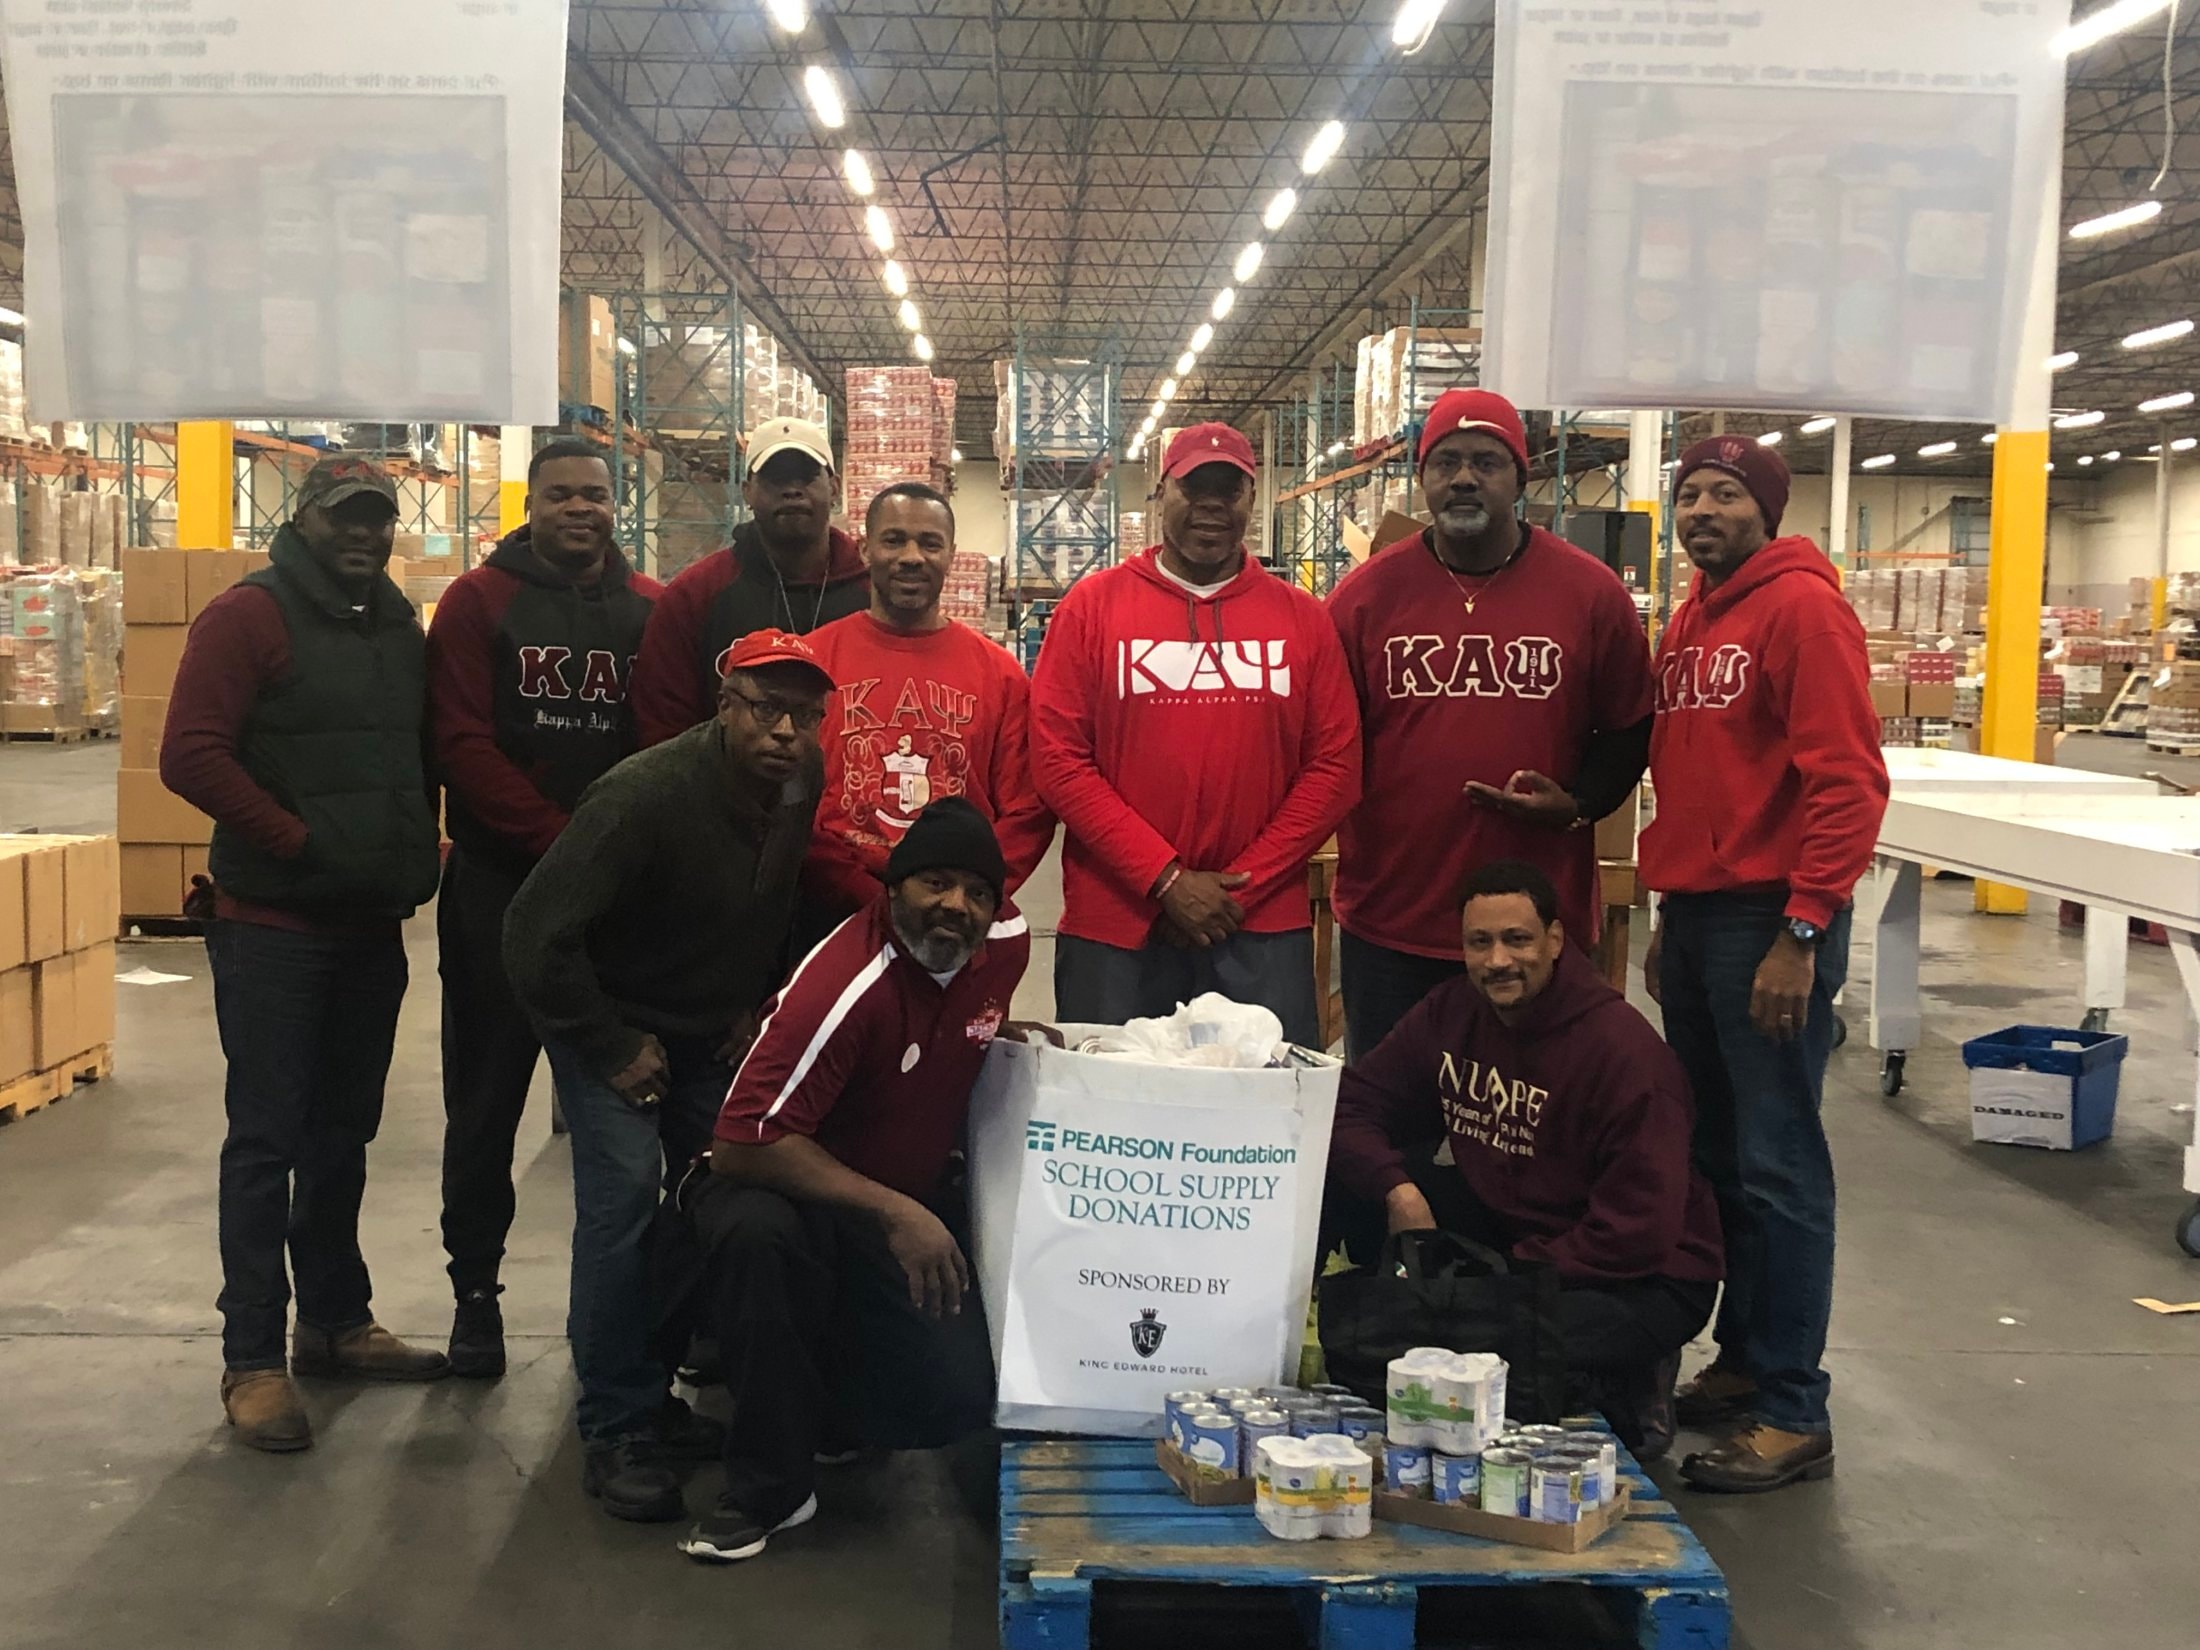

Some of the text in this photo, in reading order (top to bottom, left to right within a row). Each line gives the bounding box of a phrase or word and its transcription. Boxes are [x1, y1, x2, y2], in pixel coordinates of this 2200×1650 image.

[1973, 1105, 2065, 1120] DAMAGED
[1062, 1129, 1297, 1165] PEARSON Foundation
[1042, 1158, 1280, 1201] SCHOOL SUPPLY
[1068, 1194, 1251, 1231] DONATIONS
[1078, 1268, 1231, 1295] SPONSORED BY
[1113, 1362, 1166, 1374] EDWARD
[1170, 1366, 1208, 1376] HOTEL
